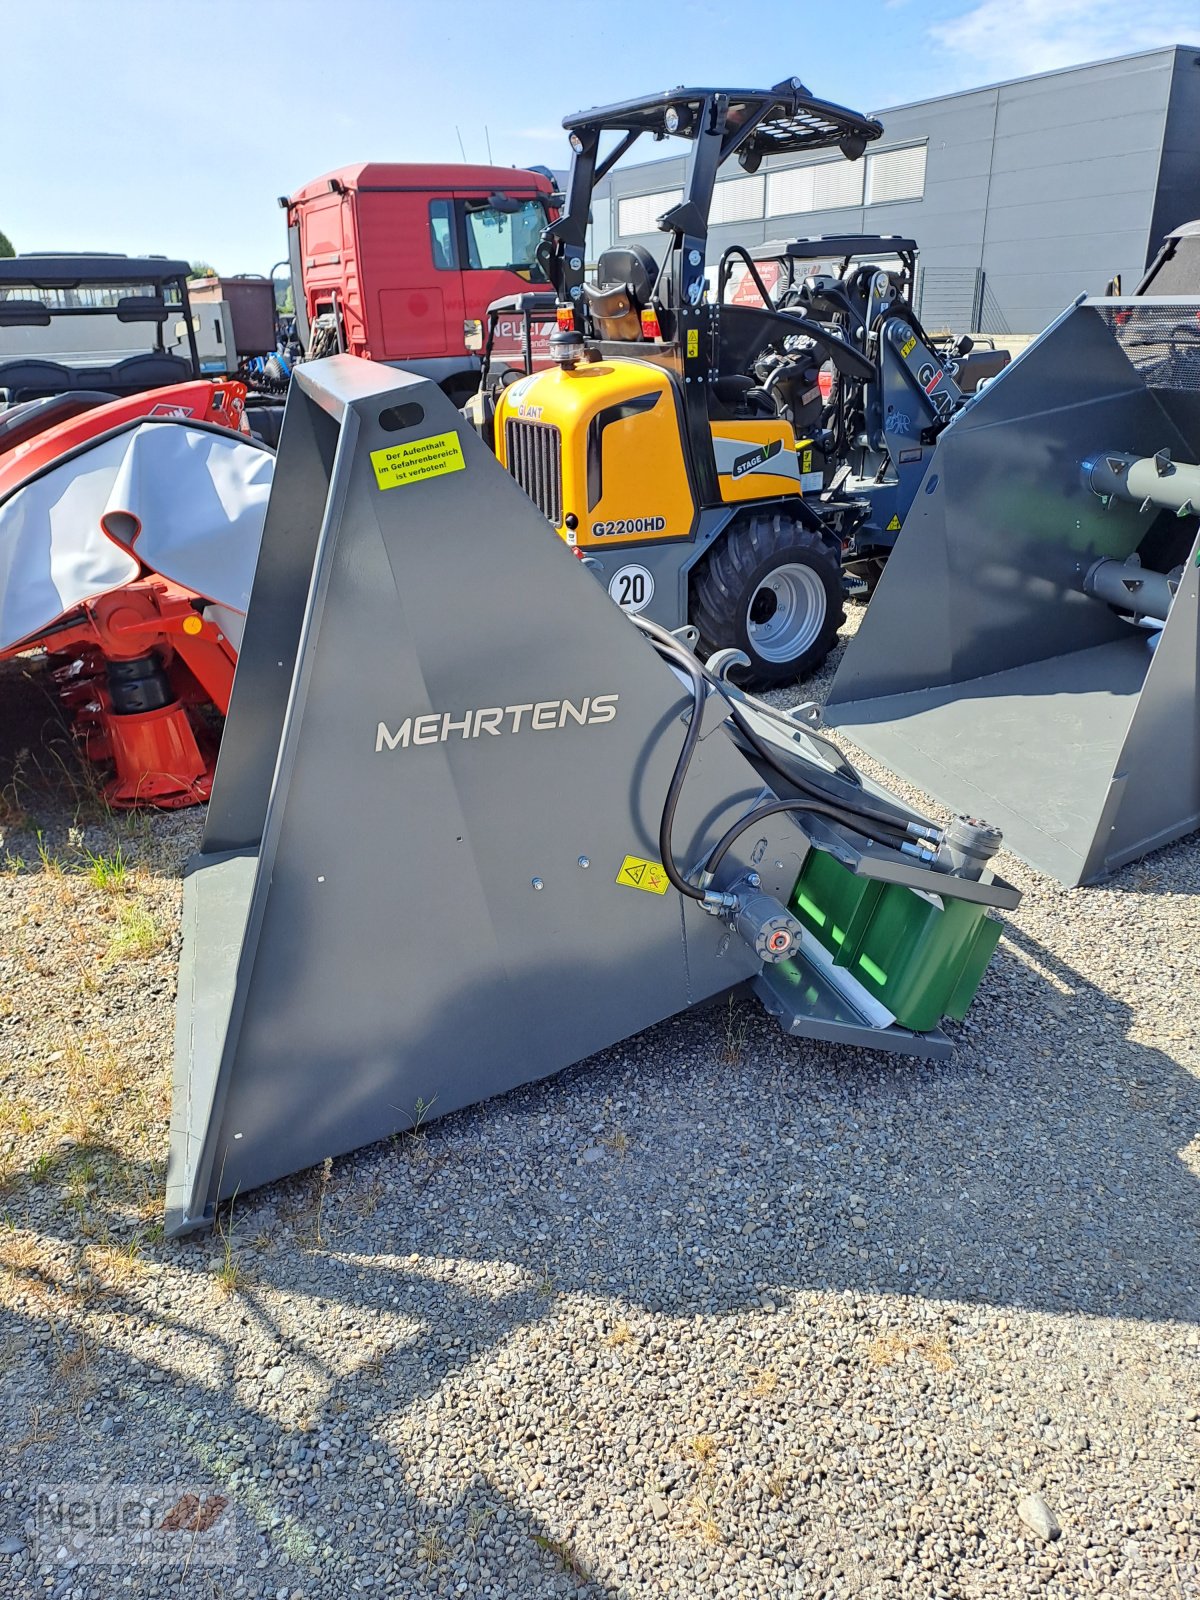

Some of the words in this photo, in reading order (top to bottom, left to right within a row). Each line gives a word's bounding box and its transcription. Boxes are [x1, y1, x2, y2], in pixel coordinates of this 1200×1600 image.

[378, 466, 389, 474] im
[390, 448, 459, 471] Gefahrenbereich
[385, 451, 401, 461] Der
[403, 440, 446, 457] Aufenthalt
[395, 472, 408, 480] ist
[408, 461, 447, 477] verboten!
[736, 455, 762, 474] STAGE
[592, 515, 666, 537] G2200HD
[618, 573, 645, 606] 20
[375, 694, 619, 752] MEHRTENS
